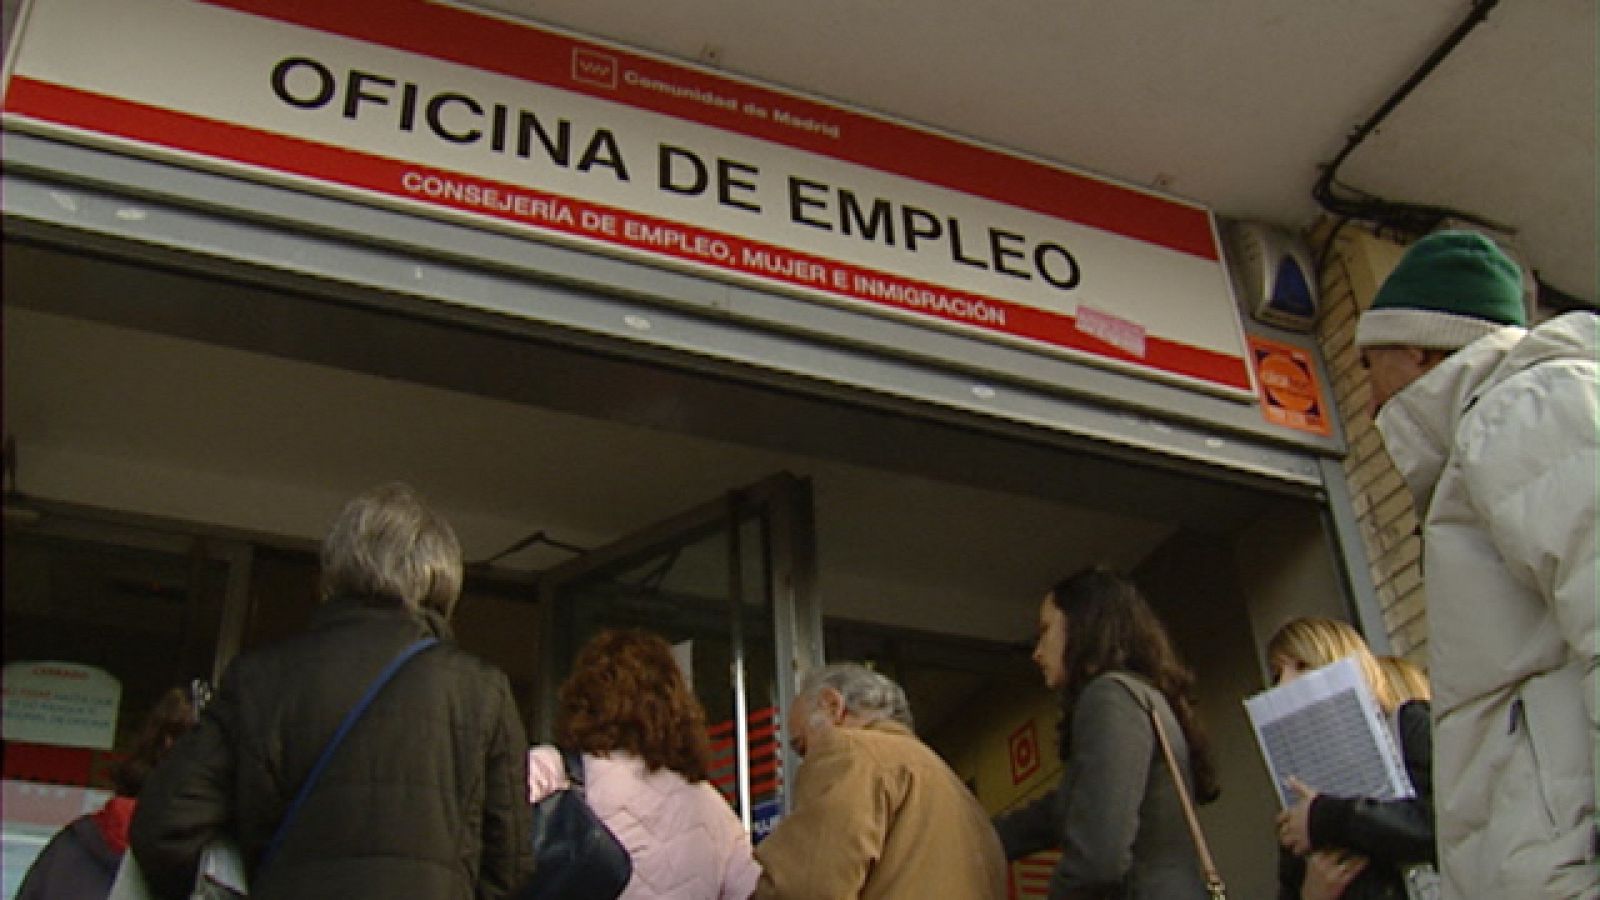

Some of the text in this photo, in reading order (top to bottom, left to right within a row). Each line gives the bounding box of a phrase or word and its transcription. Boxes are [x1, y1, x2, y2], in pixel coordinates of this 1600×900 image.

[270, 56, 1081, 291] OFICINA DE EMPLEO
[624, 70, 840, 138] Comunidad de Madrid
[402, 171, 1006, 326] CONSEJERÍA DE EMPLEO, MUJER E INMIGRACIÓN
